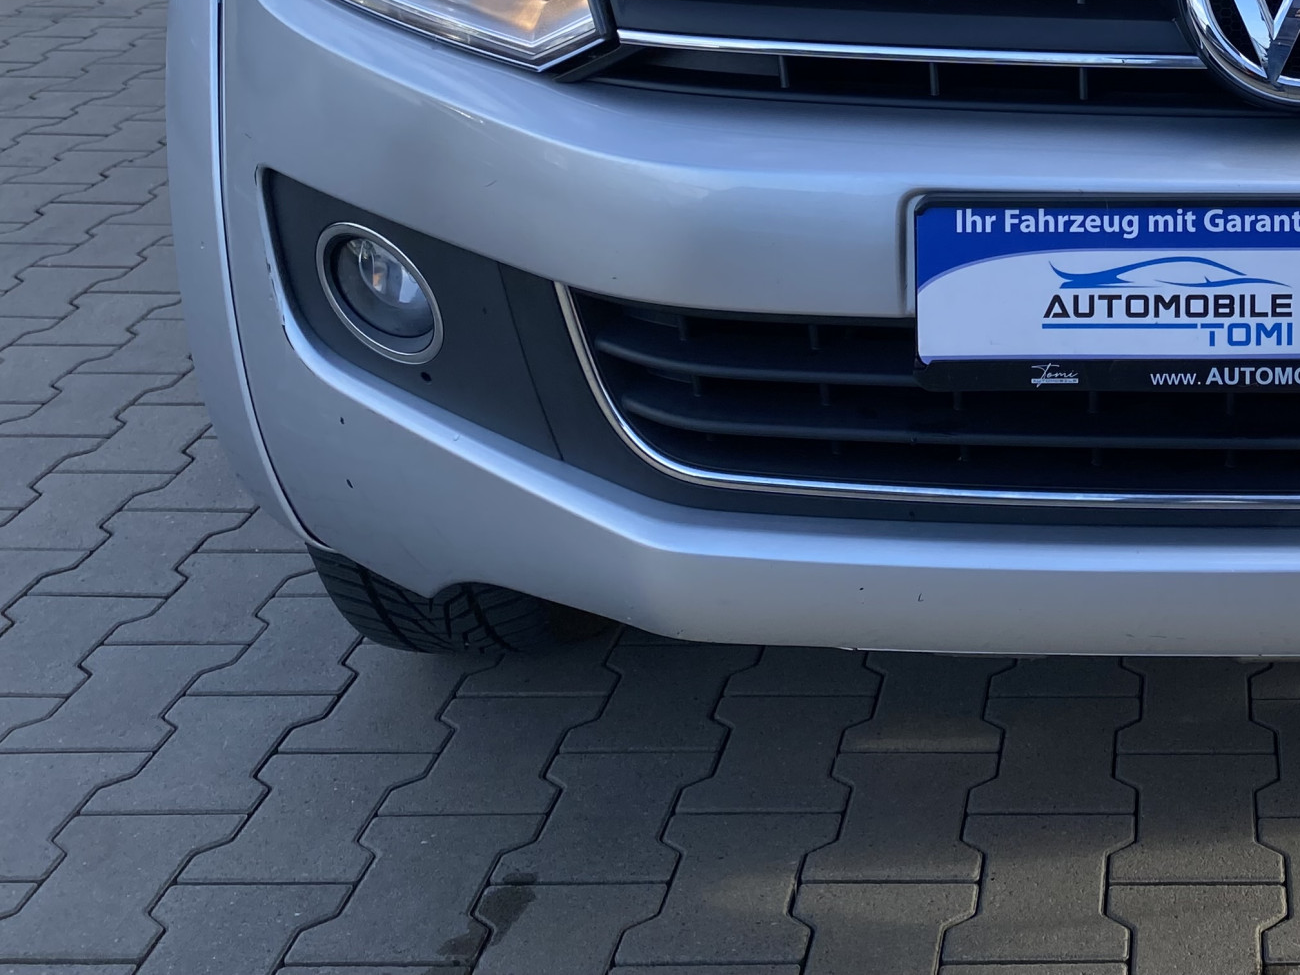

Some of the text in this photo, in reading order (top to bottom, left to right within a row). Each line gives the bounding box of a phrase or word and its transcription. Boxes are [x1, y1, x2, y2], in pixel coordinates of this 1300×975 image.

[955, 209, 996, 233] Ihr
[1004, 209, 1139, 238] Fahrzeug
[1148, 209, 1196, 233] mit
[1043, 294, 1293, 318] AUTOMOBILE
[1200, 322, 1293, 346] TOMI
